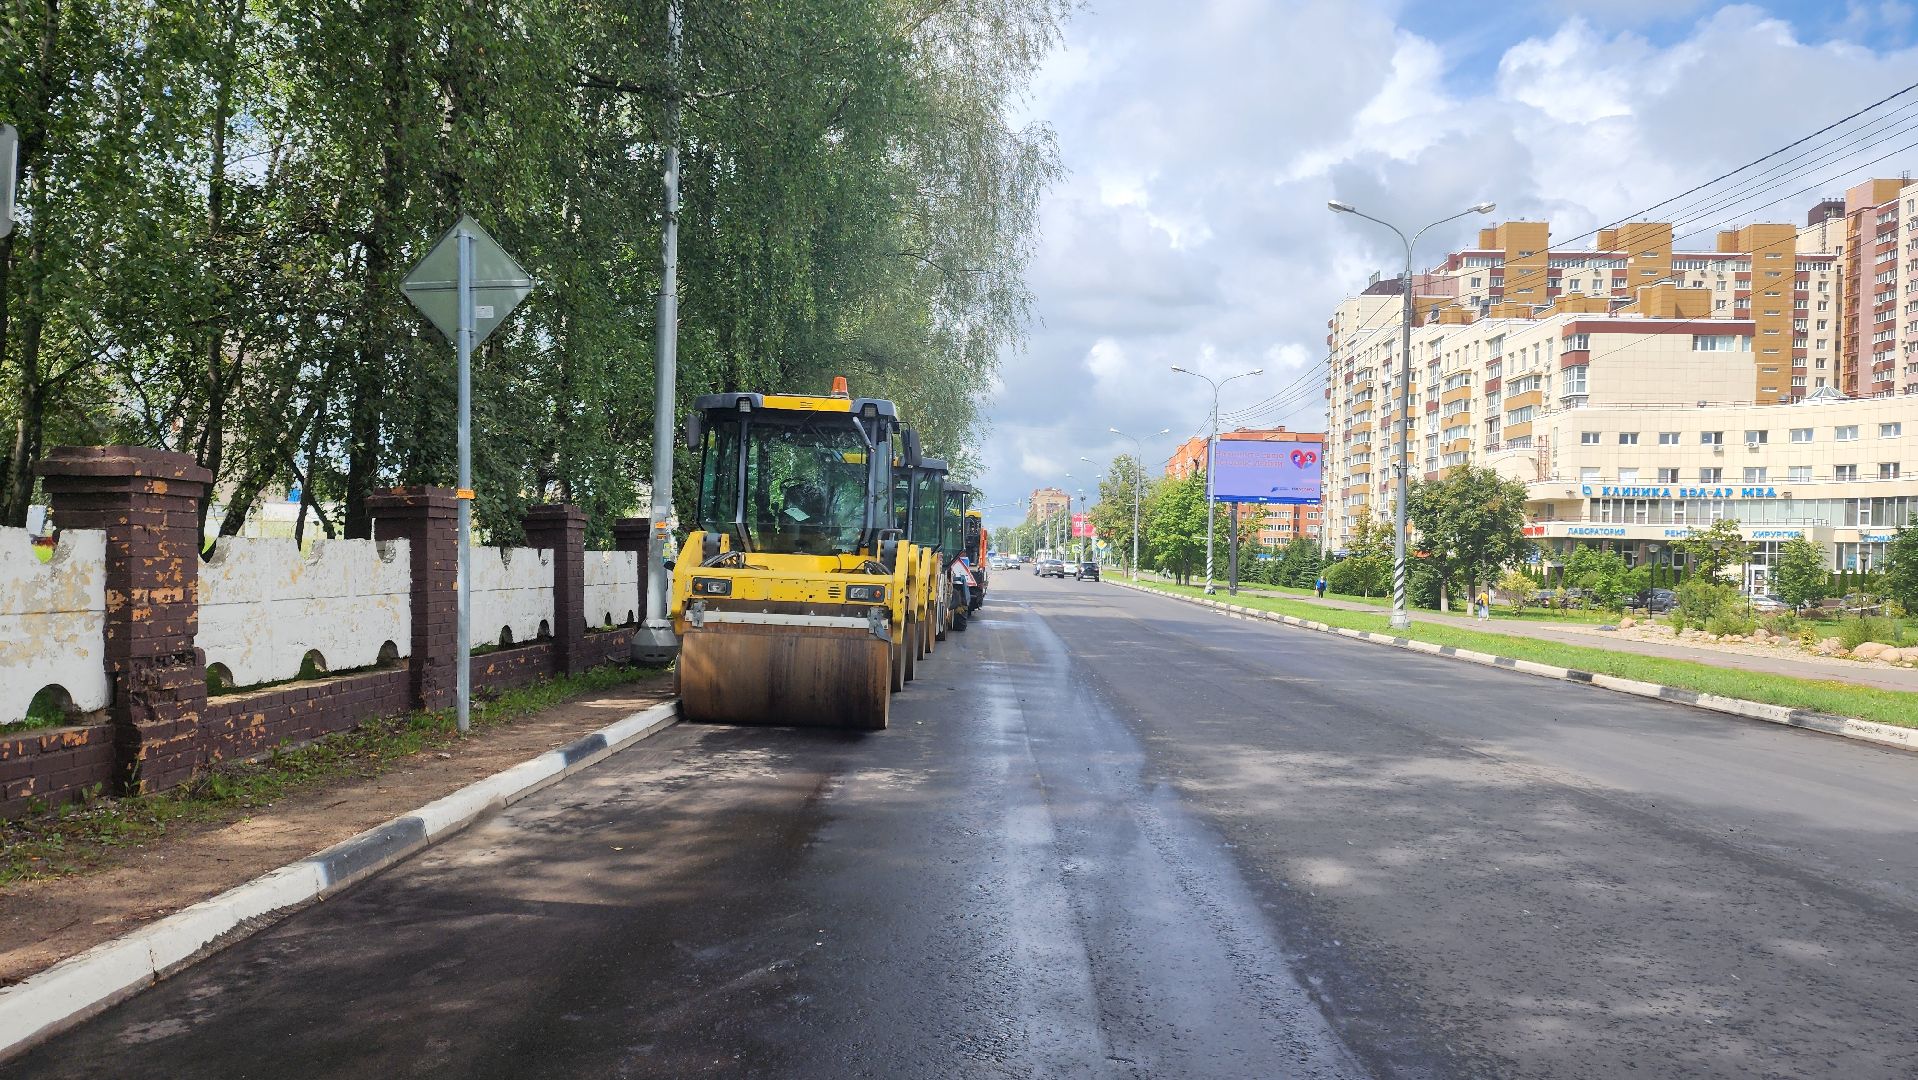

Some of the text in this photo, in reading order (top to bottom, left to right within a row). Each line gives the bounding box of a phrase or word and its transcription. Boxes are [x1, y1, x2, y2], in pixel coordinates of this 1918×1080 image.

[1602, 486, 1671, 497] КЛИНИКА
[1741, 487, 1777, 498] МЕД
[1567, 527, 1626, 536] ЛАБОРАТОРИЯ
[1752, 530, 1801, 539] ХИРУРГИЯ
